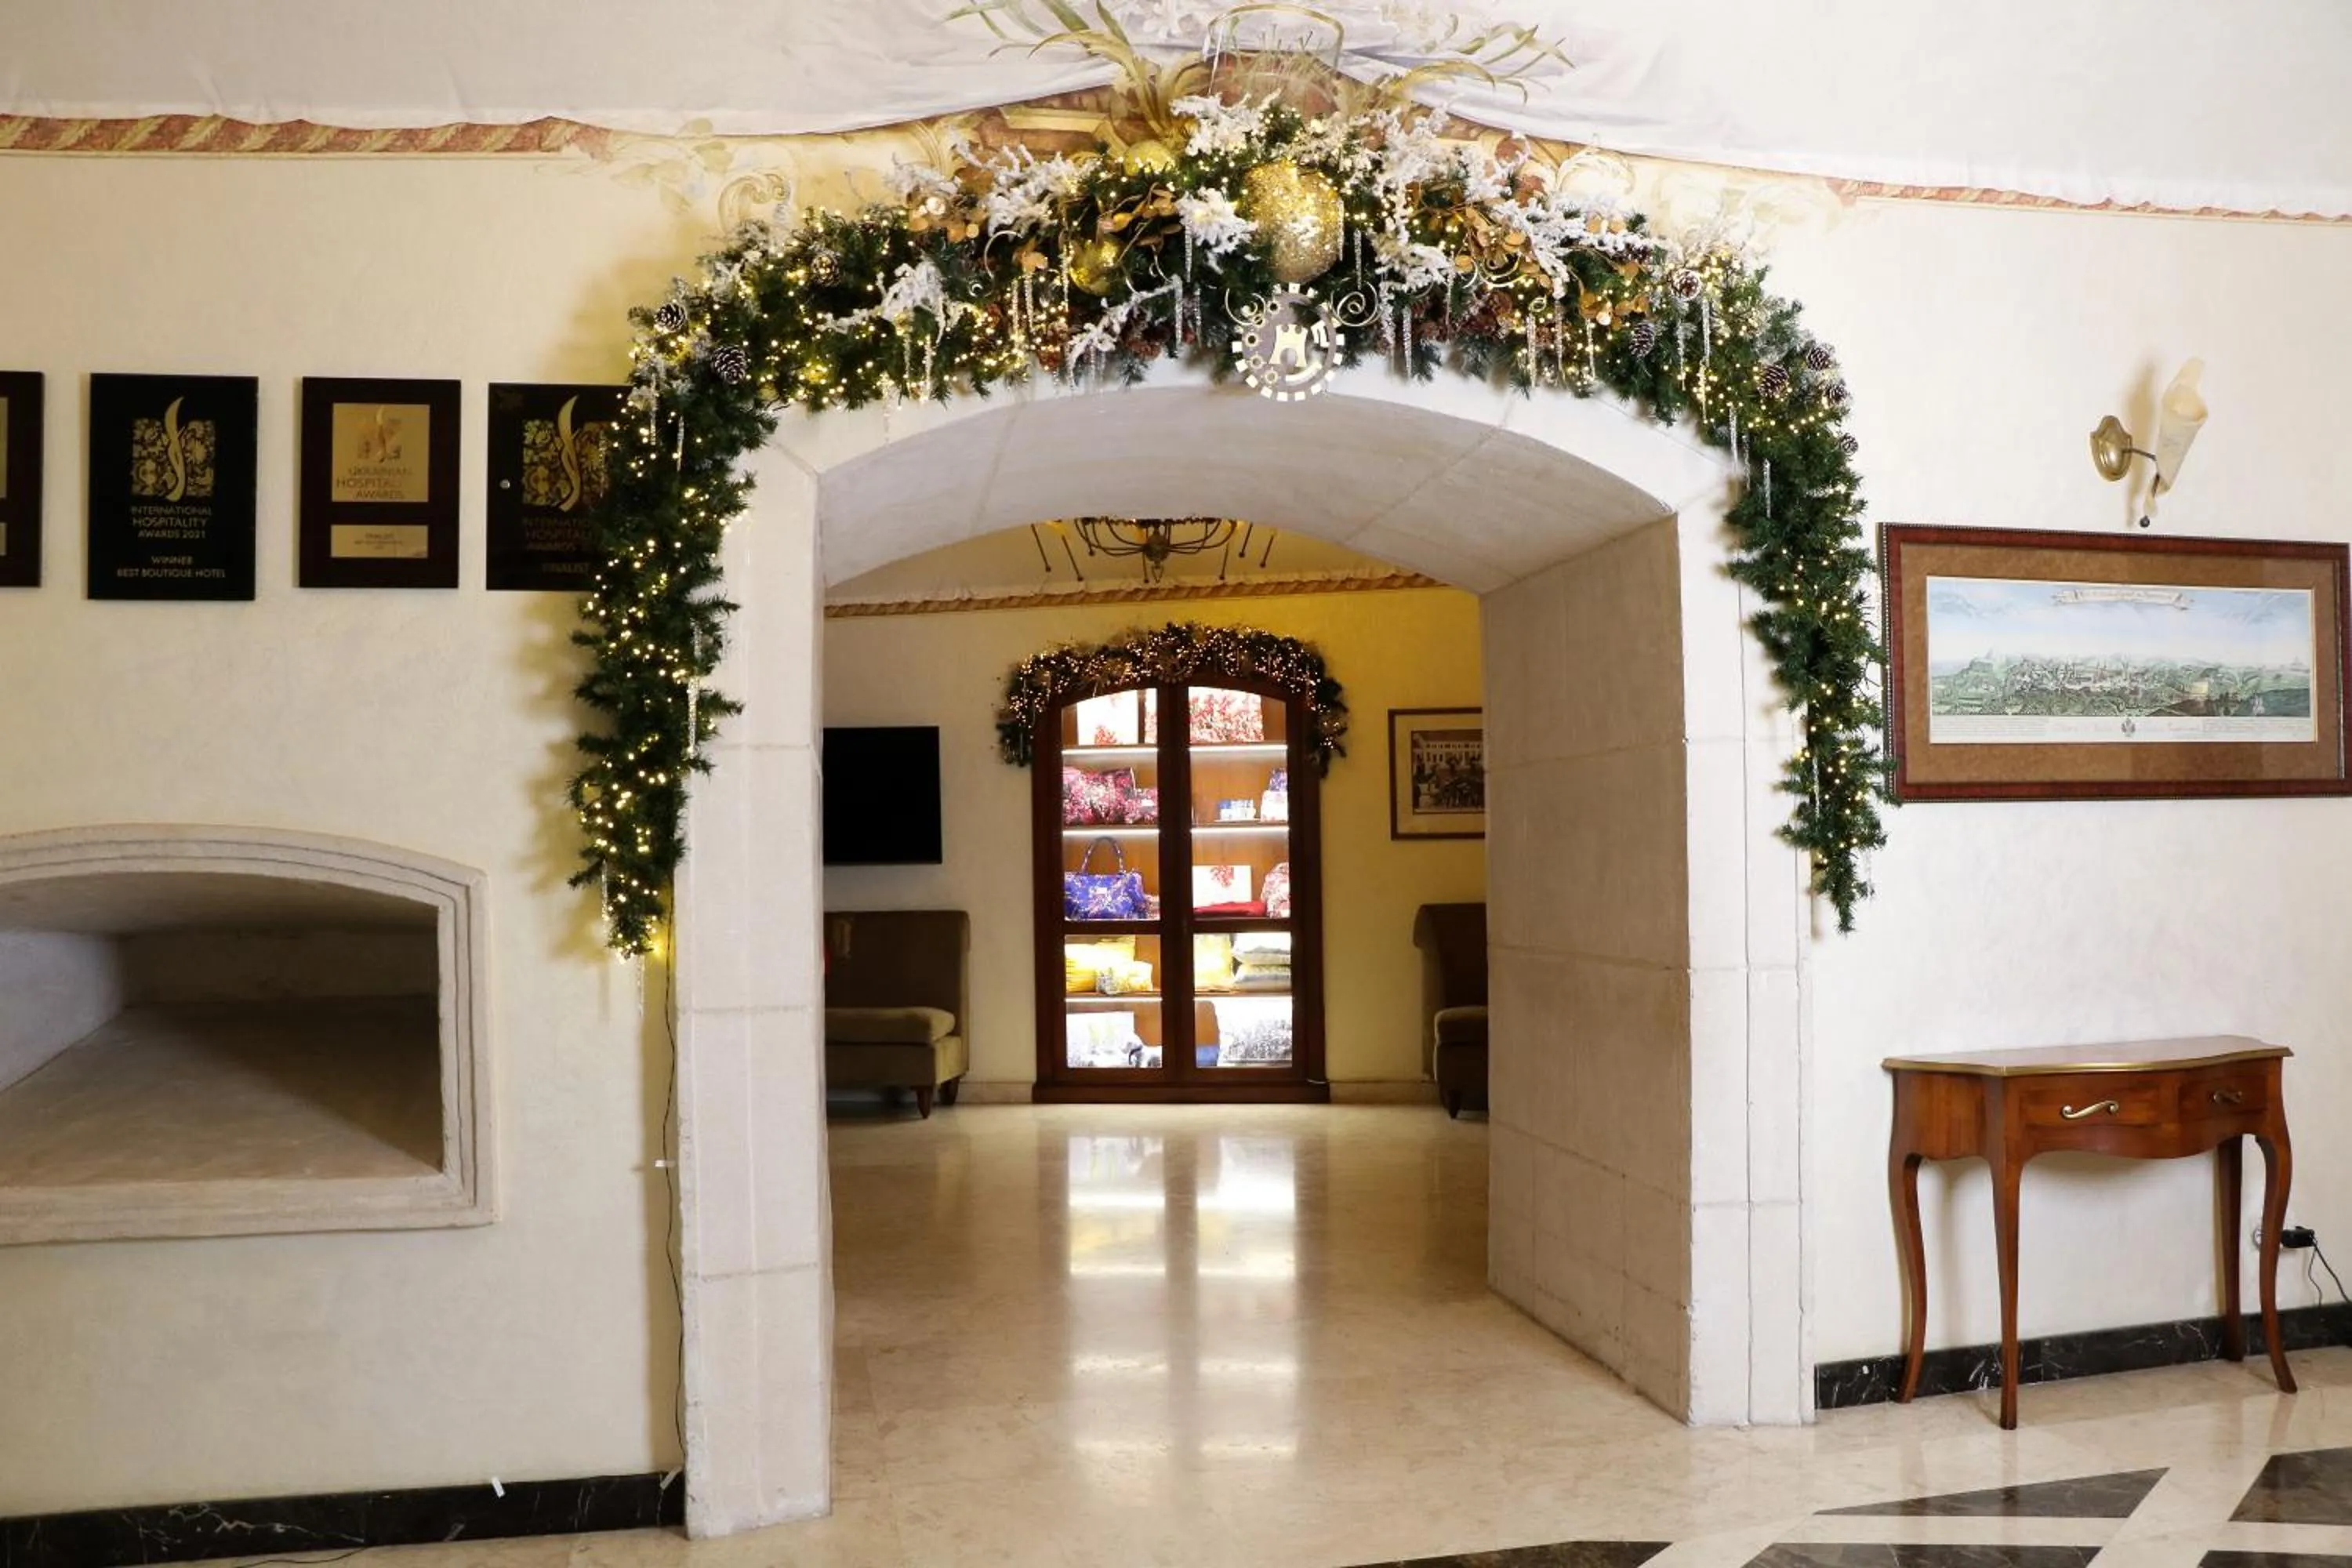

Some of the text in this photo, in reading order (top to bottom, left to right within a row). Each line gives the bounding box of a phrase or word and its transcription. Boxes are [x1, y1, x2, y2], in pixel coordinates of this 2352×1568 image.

[130, 506, 212, 516] INTERNATIONAL
[132, 516, 209, 528] HOSPITALITY
[137, 529, 205, 539] AWARDS 2021
[151, 555, 194, 565] WINNER
[116, 568, 226, 579] BEST BOUTIQUE HOTEL
